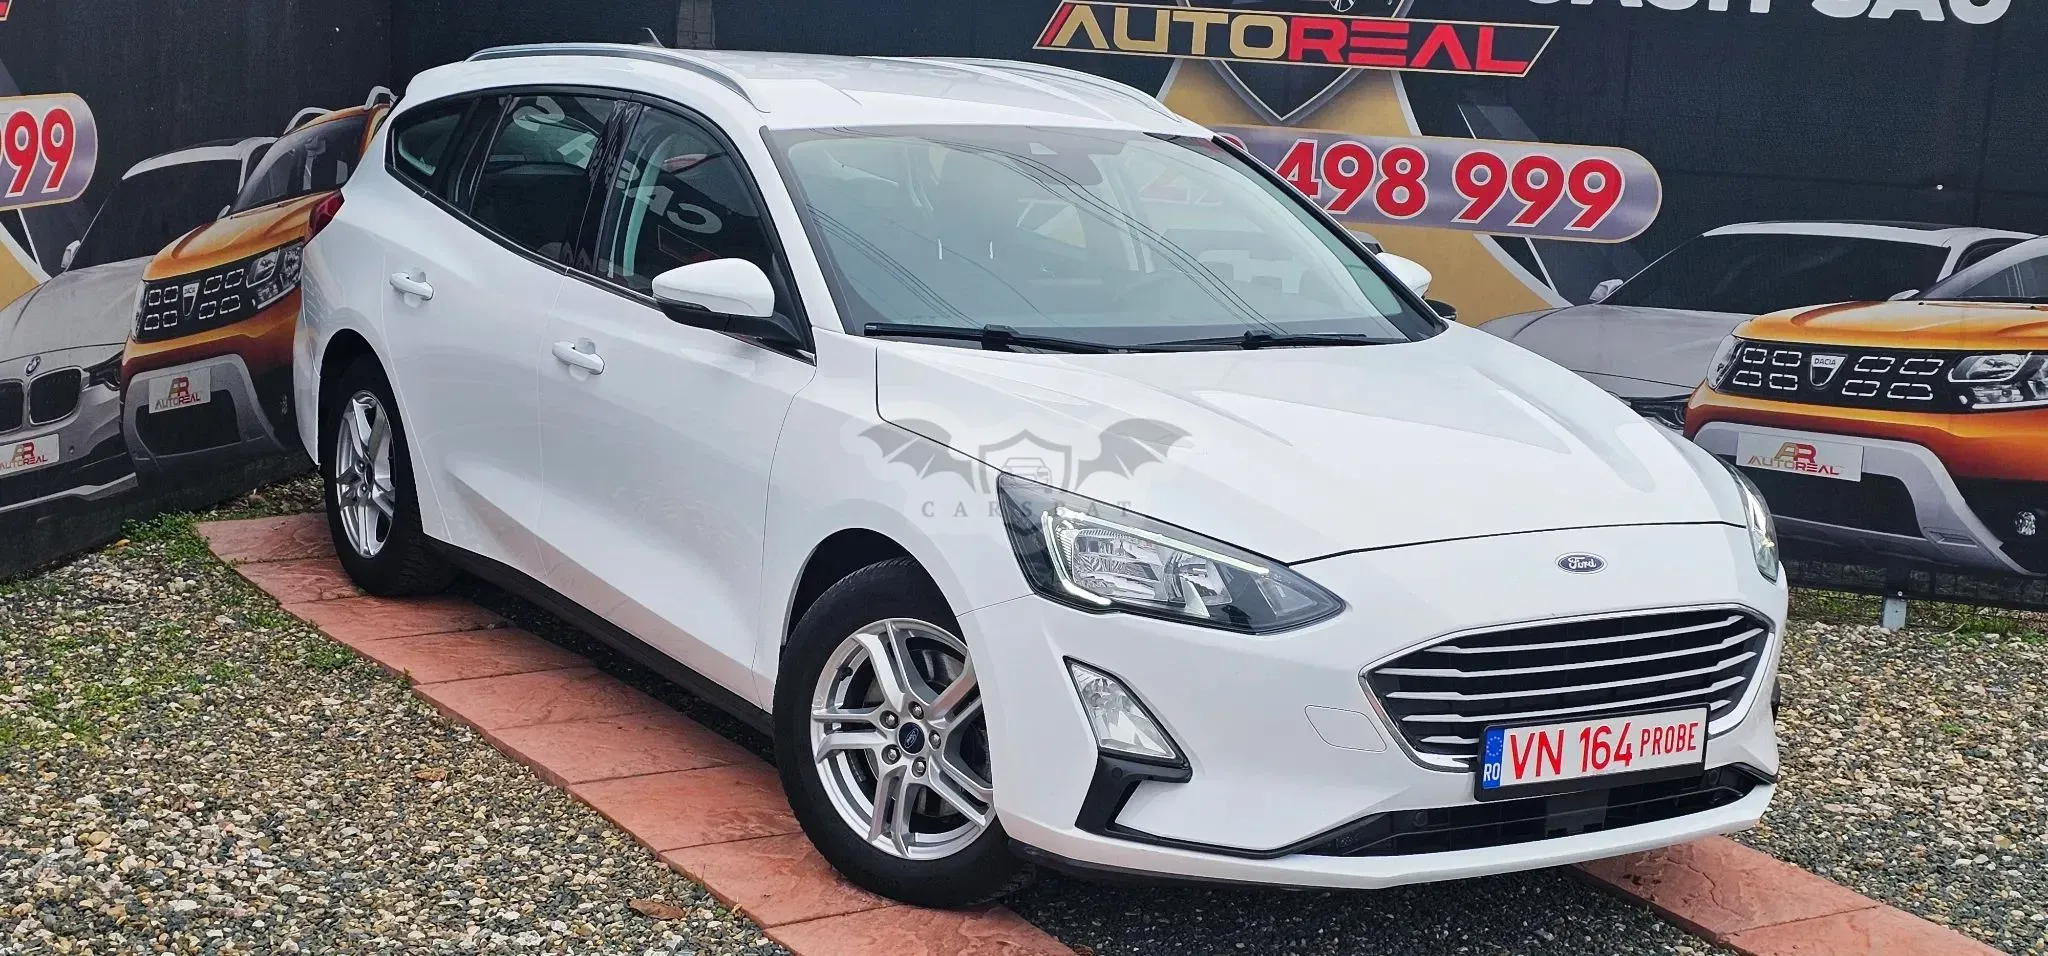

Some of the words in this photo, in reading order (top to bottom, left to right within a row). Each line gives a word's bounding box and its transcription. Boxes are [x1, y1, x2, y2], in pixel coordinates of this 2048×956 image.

[1041, 3, 1529, 73] AUTOREAL
[0, 106, 76, 198] 99
[1275, 139, 1429, 220] 498
[1451, 150, 1625, 232] 999
[1747, 455, 1840, 476] AUTOREAL
[1568, 556, 1597, 570] Ford
[1483, 763, 1500, 782] RO
[1510, 730, 1565, 780] VN
[1579, 722, 1633, 773] 164
[1640, 722, 1699, 757] PROBE
